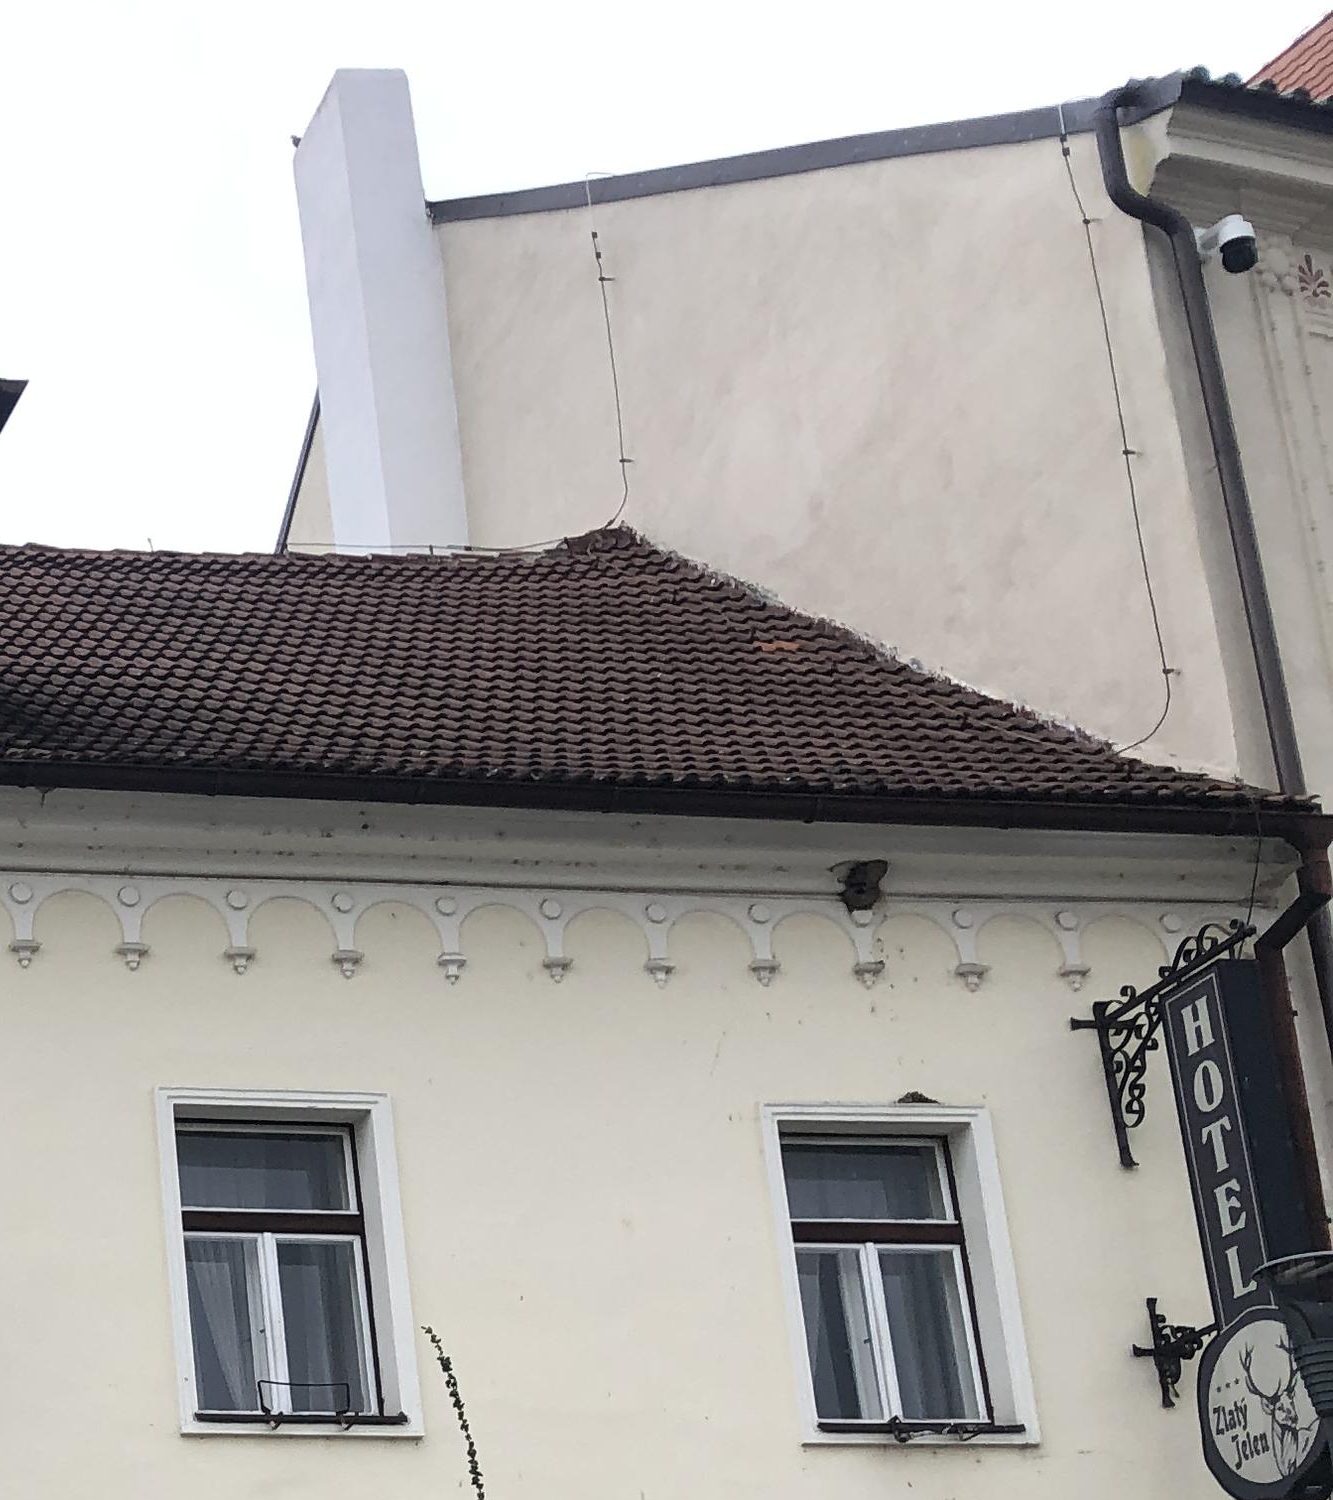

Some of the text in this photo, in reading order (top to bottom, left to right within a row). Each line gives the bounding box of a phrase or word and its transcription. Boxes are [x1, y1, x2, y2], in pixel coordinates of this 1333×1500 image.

[1180, 995, 1257, 1299] HOTEL
[1212, 1397, 1249, 1436] Zlatý
[1231, 1431, 1271, 1470] Jelen
